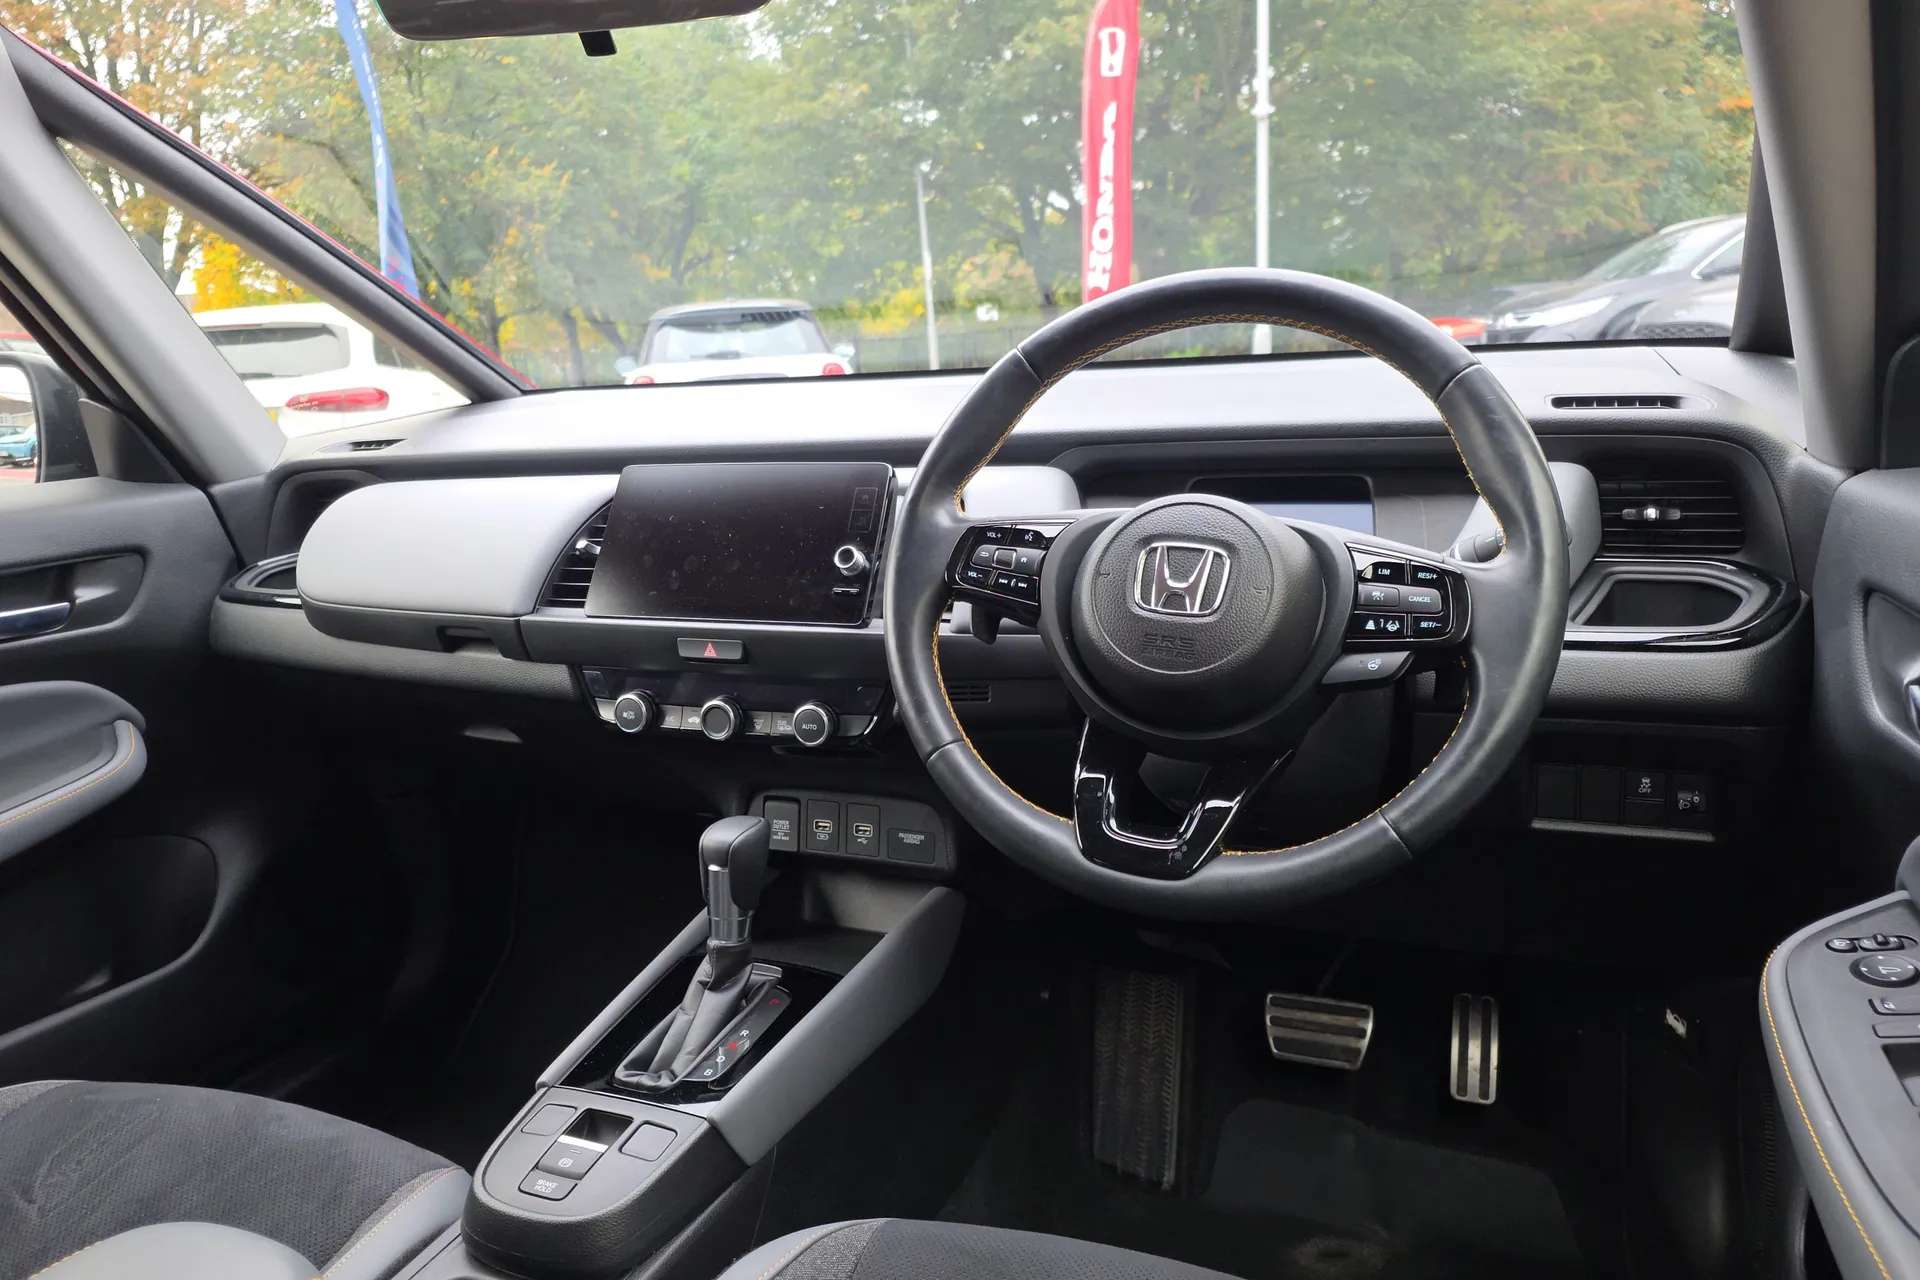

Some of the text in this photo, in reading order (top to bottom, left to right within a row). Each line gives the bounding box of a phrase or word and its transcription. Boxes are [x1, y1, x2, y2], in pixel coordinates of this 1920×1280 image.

[1408, 595, 1432, 603] CANCEL
[802, 723, 818, 731] AUTO
[740, 1029, 750, 1037] R
[716, 1055, 726, 1063] D
[534, 1185, 553, 1193] HOLD
